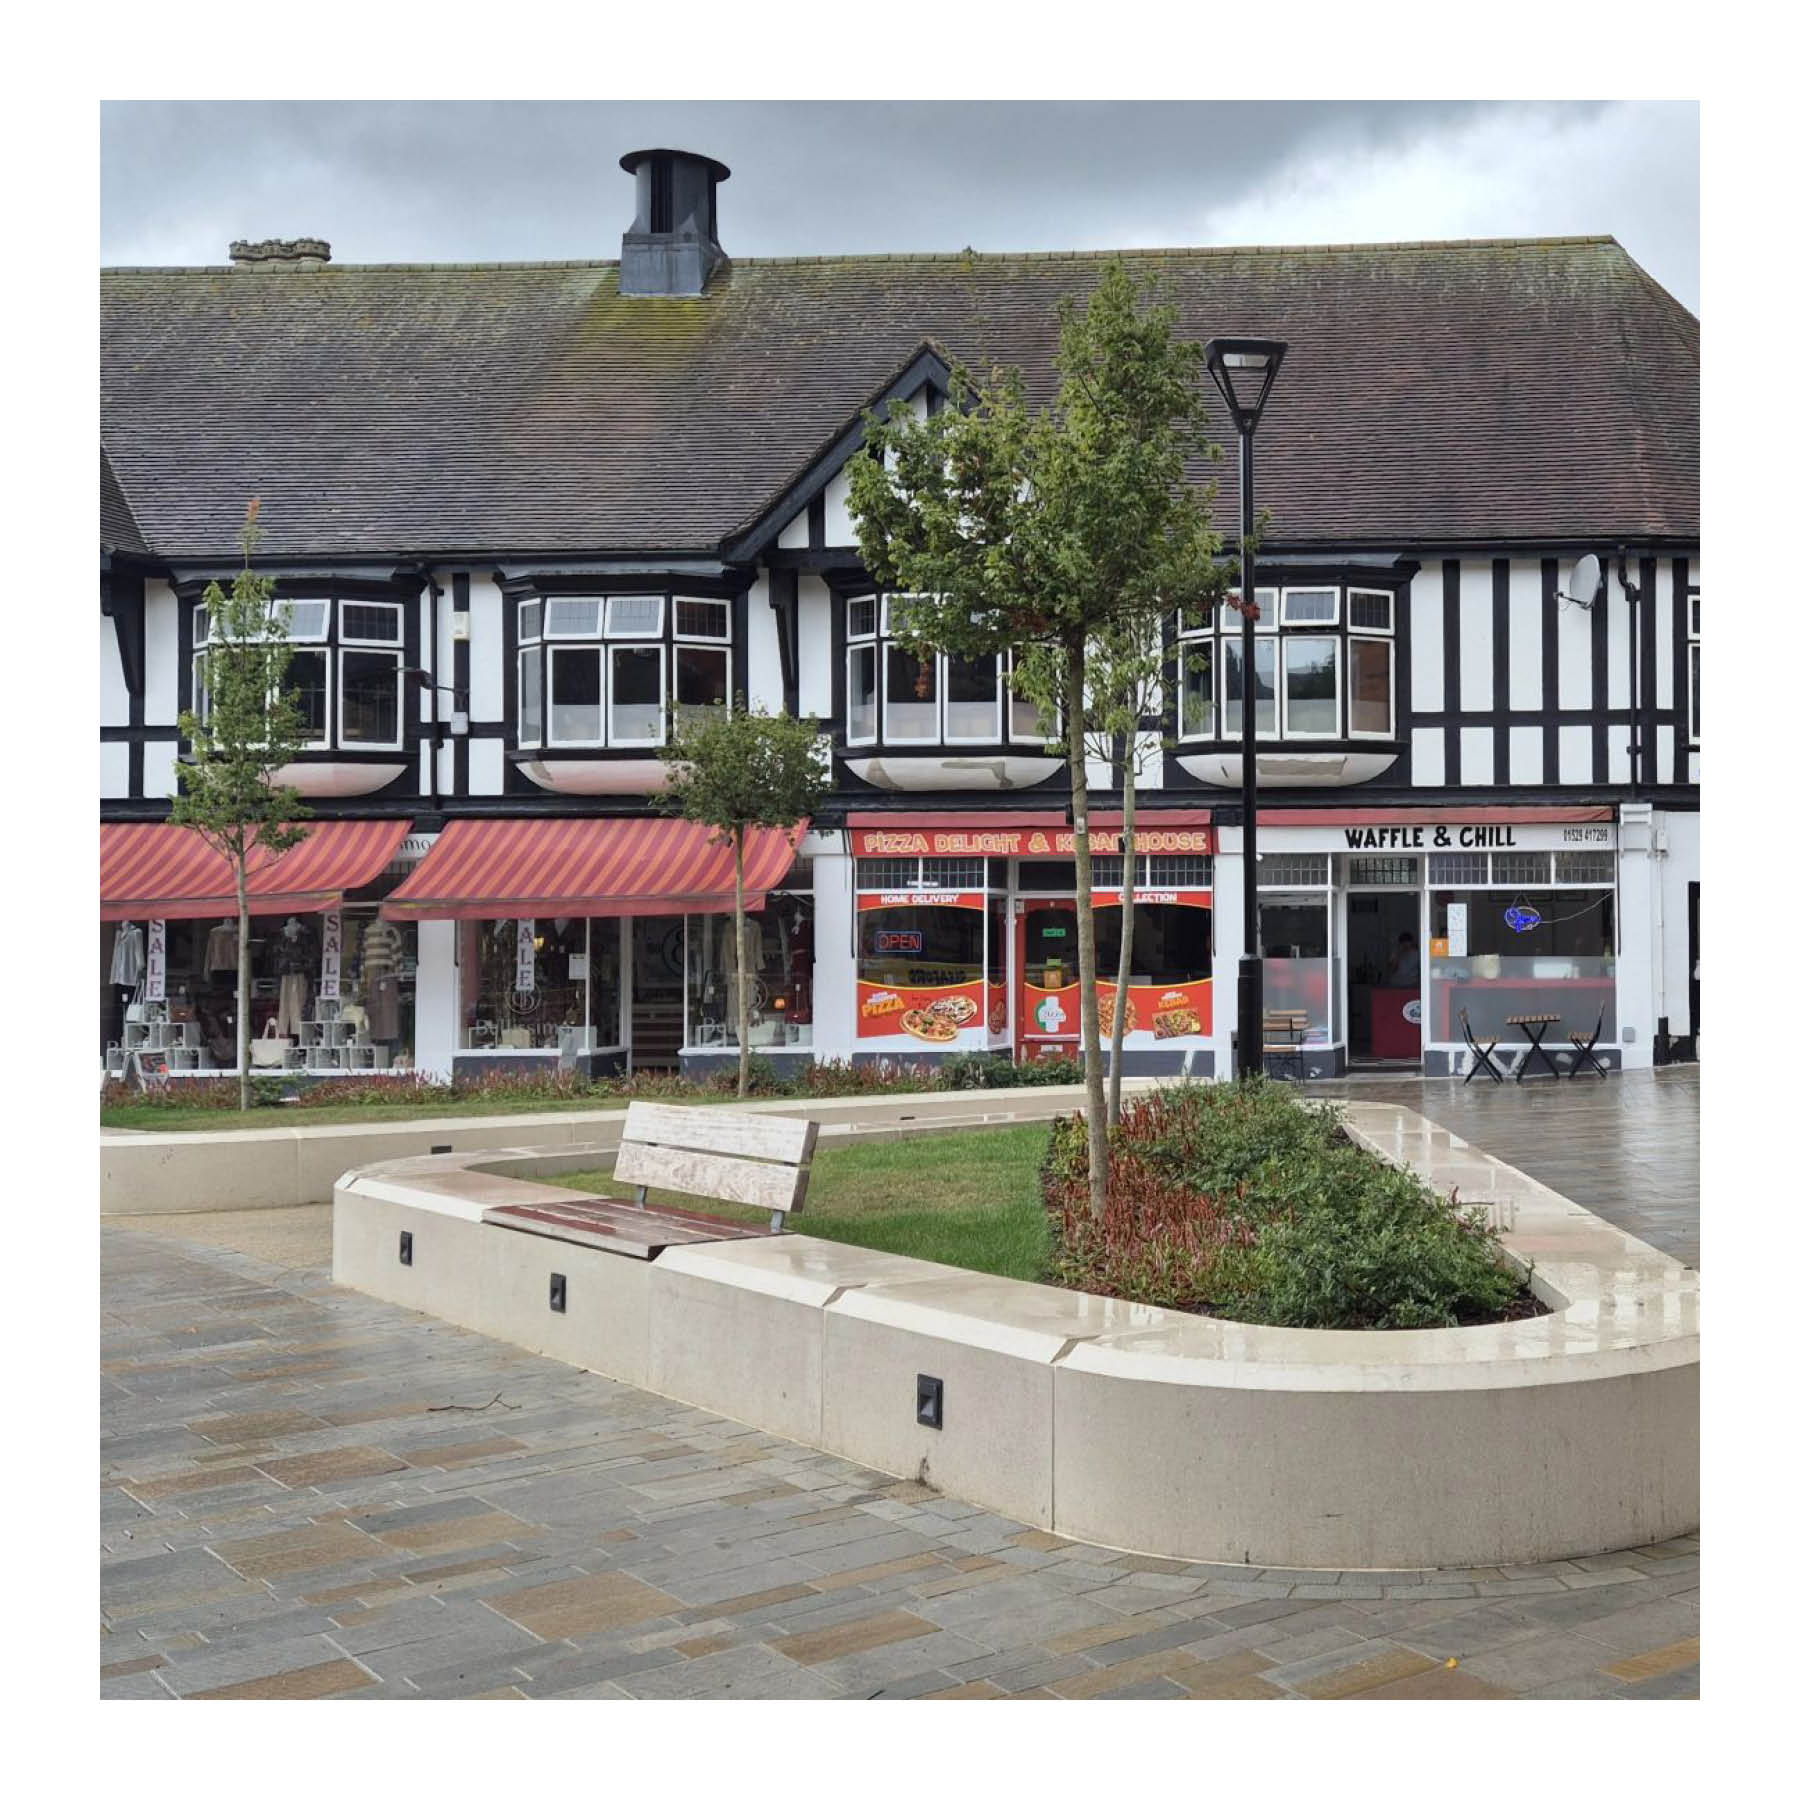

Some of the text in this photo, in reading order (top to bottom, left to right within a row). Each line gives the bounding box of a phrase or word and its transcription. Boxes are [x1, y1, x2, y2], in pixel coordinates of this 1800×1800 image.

[934, 832, 1021, 854] DELIGHT
[1028, 832, 1050, 853] &
[1134, 832, 1206, 853] HOUSE
[1344, 825, 1516, 849] WAFFLE & CHILL
[1563, 828, 1583, 842] 01529
[880, 893, 960, 904] HOME DELIVERY
[879, 934, 920, 950] OPEN
[149, 919, 165, 998] SALE
[325, 914, 340, 996] SALE
[519, 919, 533, 988] ALE
[862, 997, 905, 1017] PIZZA
